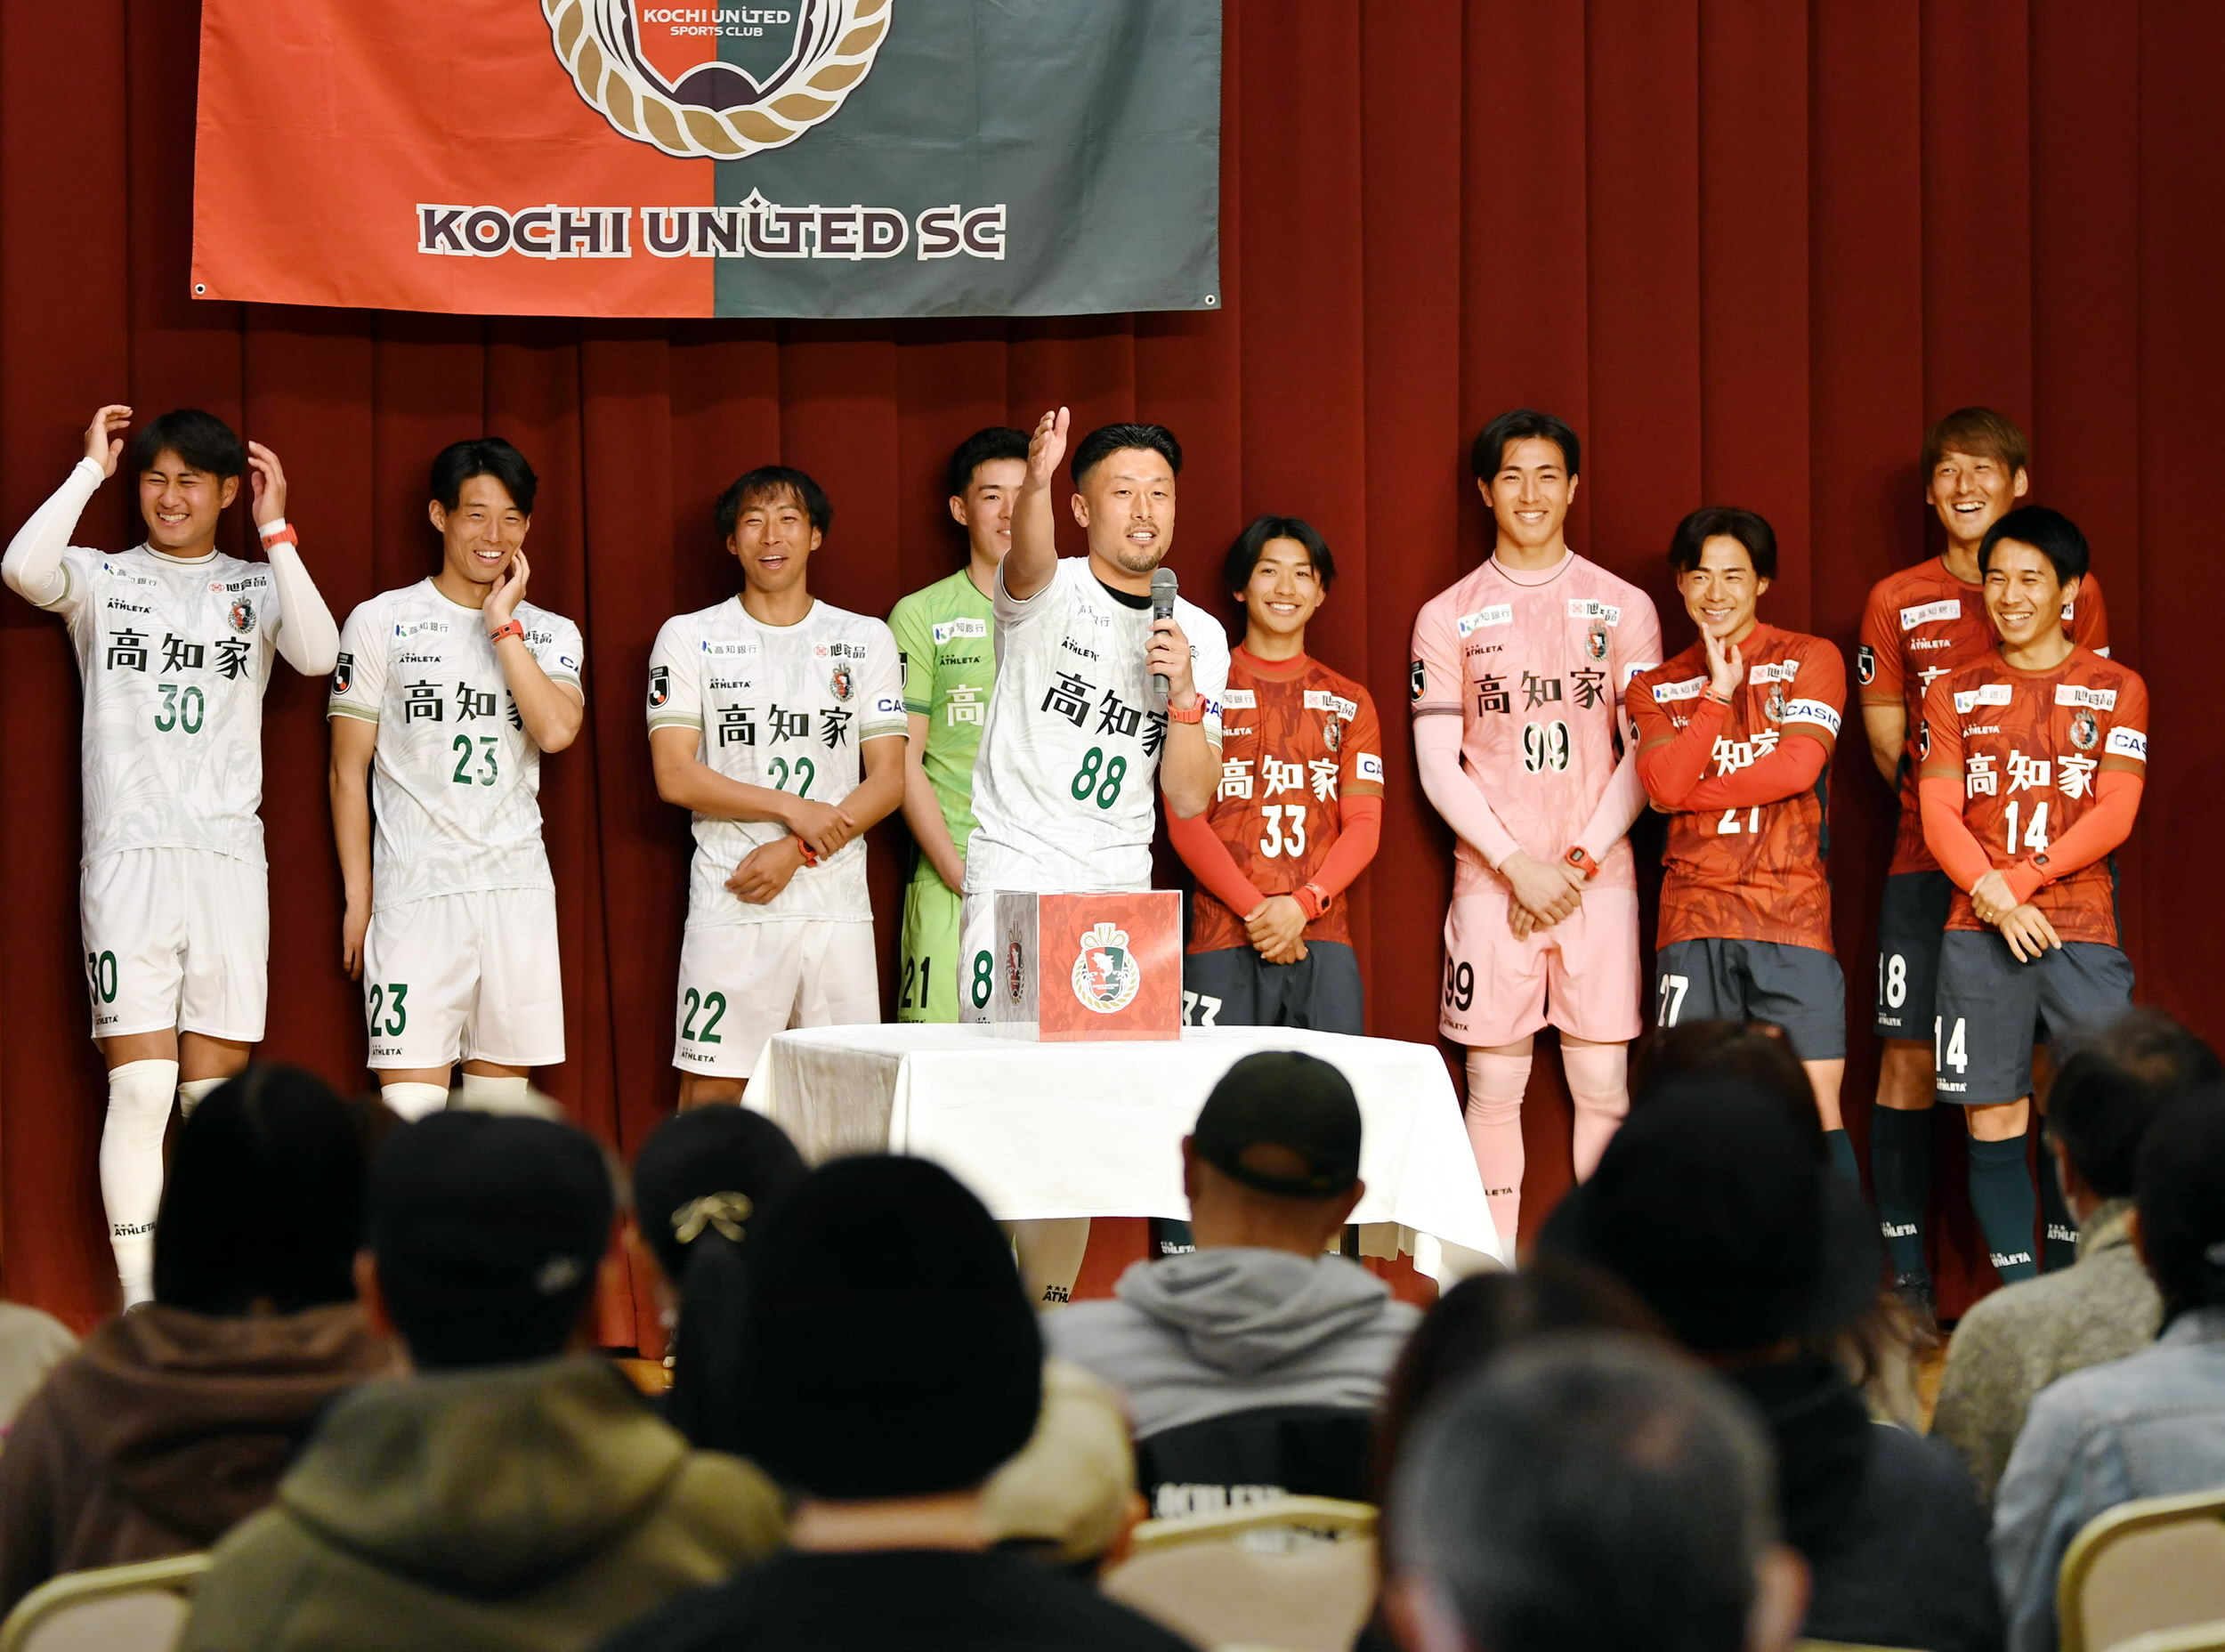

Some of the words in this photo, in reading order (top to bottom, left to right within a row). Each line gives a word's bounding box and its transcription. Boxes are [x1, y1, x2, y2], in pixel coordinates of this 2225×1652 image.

[643, 9, 707, 23] KOCHI
[670, 26, 724, 36] SPORTS
[725, 27, 764, 36] CLUB
[416, 204, 632, 260] KOCHI
[917, 204, 1007, 260] SC
[107, 601, 150, 614] ATHLETA
[107, 628, 251, 681] 高知家
[399, 655, 441, 663] ATHLETA
[714, 644, 757, 654] 高知銀行
[940, 657, 981, 666] ATHLETA
[1466, 645, 1503, 658] ATHLETA
[1910, 639, 1951, 650] ATHLETA
[154, 684, 205, 734] 30
[709, 681, 751, 689] ATHLETA
[1474, 667, 1606, 717] 高知家
[717, 703, 854, 749] 高知家
[1785, 705, 1841, 733] CASIO
[1962, 725, 2000, 738] ATHLETA
[452, 733, 498, 786] 23
[1523, 720, 1570, 774] 99
[1698, 728, 1780, 779] 知家
[768, 757, 815, 802] 22
[1071, 746, 1127, 810] 88
[1217, 754, 1339, 803] 高知家
[1965, 749, 2097, 800] 高知家
[1260, 805, 1306, 858] 33
[2005, 800, 2049, 854] 14
[88, 950, 117, 1007] 30
[901, 956, 931, 1008] 21
[972, 950, 993, 1008] 8
[1445, 956, 1474, 1011] 99
[1658, 974, 1688, 1028] 27
[1879, 952, 1906, 1008] 18
[369, 984, 408, 1037] 23
[682, 987, 726, 1044] 22
[372, 1048, 402, 1056] ATHLETA
[682, 1051, 716, 1063] ATHLETA
[1934, 1016, 1968, 1074] 14
[114, 1222, 156, 1236] ATHLETA
